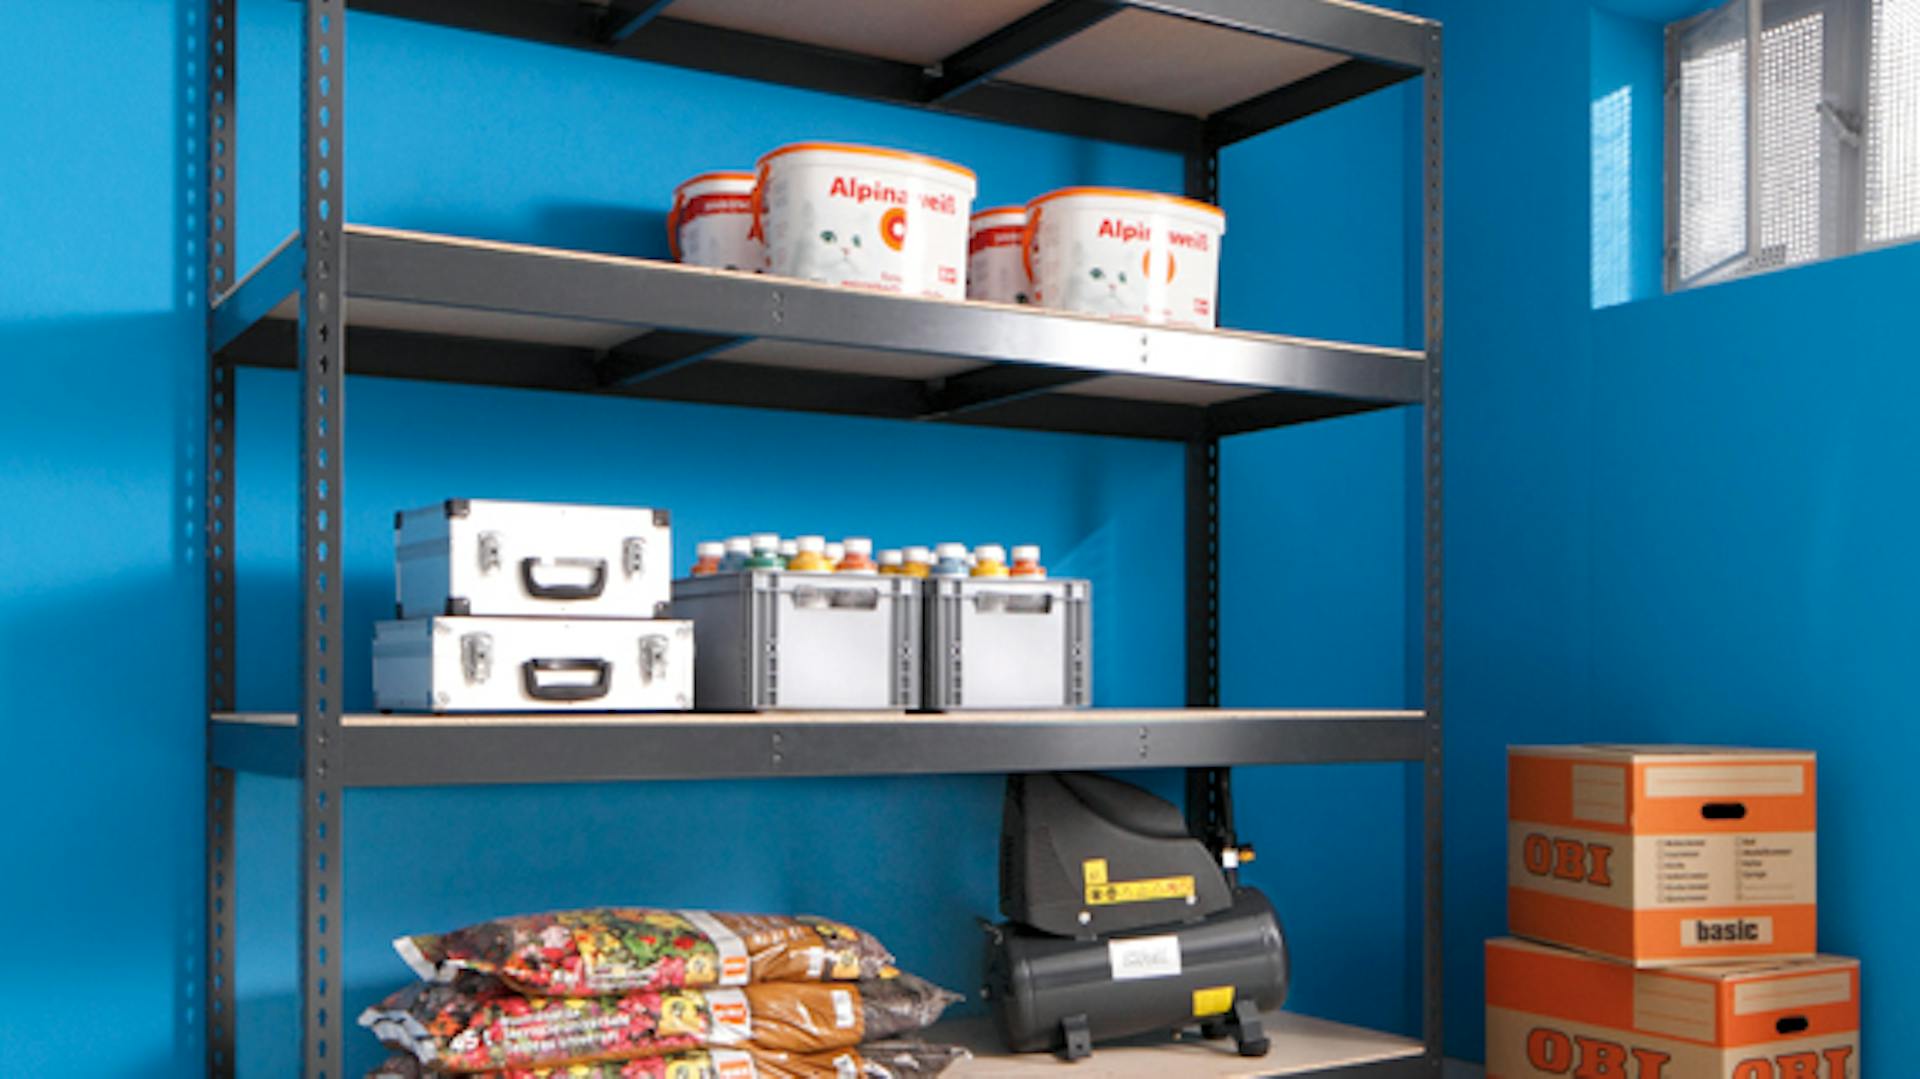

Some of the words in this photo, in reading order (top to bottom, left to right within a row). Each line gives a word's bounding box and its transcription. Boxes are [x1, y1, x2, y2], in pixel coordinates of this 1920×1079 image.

[1524, 833, 1614, 888] OBI
[1697, 918, 1758, 941] basic
[1527, 1028, 1671, 1079] OBI
